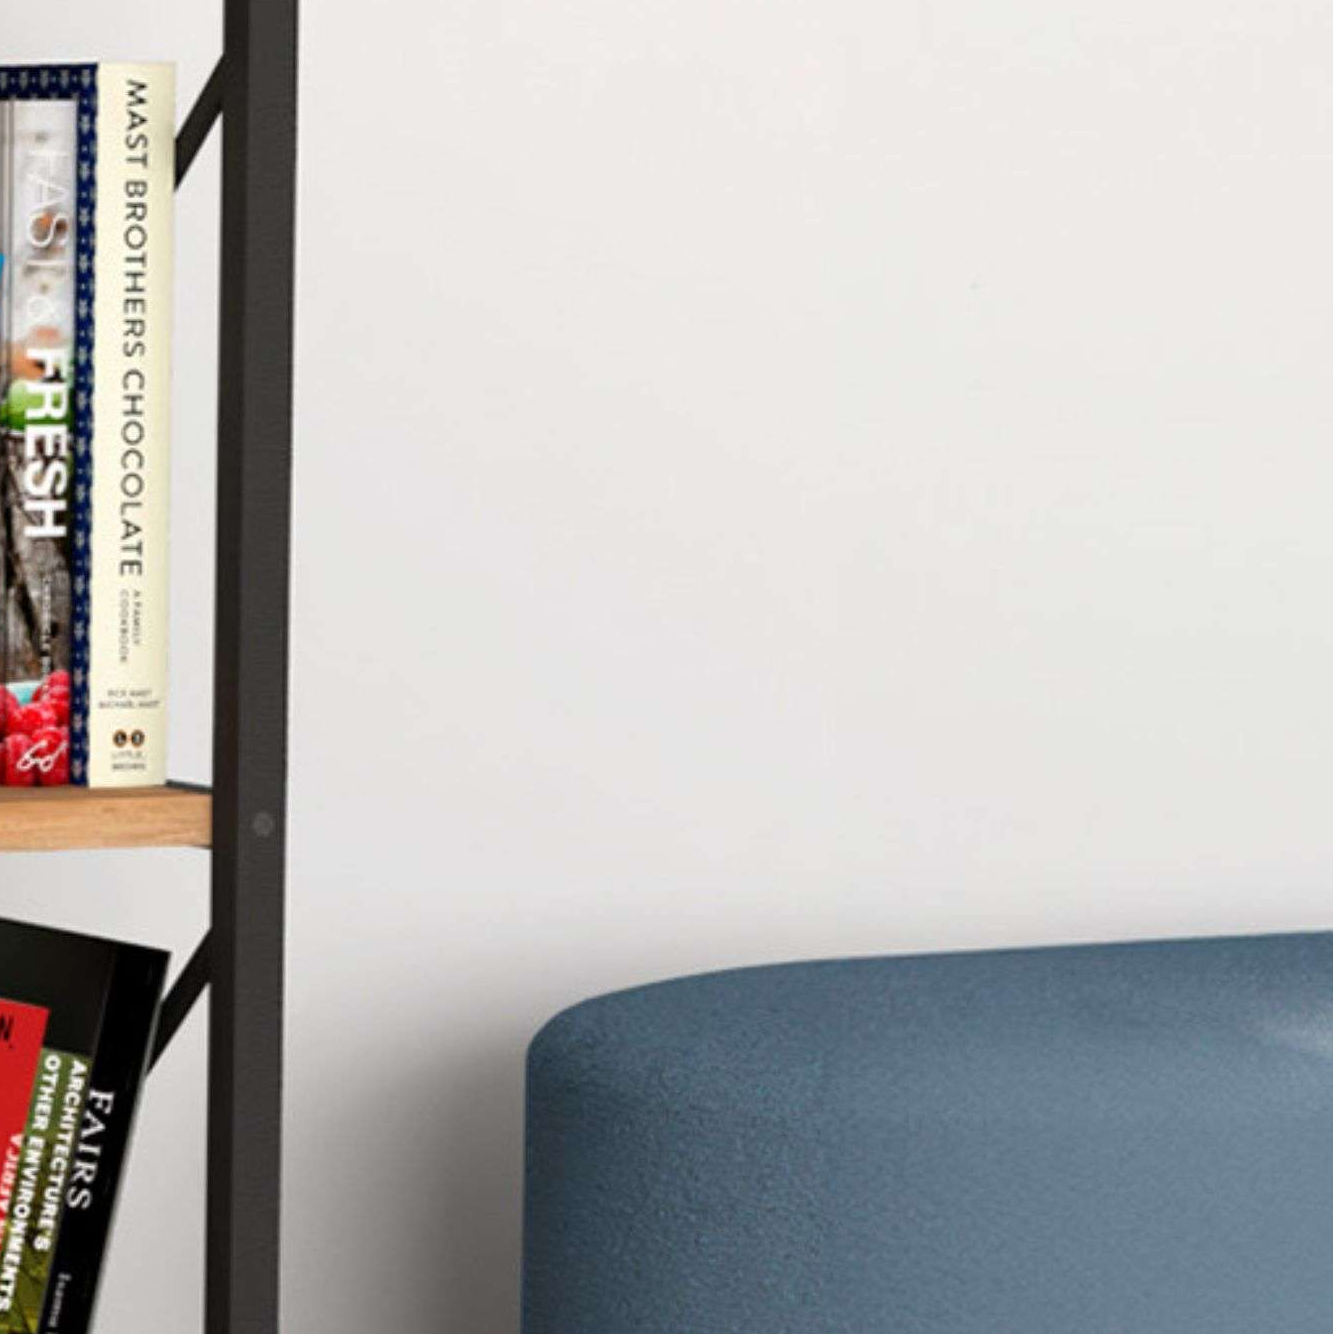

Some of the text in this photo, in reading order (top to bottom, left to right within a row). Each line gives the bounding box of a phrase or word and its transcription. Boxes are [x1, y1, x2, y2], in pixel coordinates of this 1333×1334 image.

[119, 78, 150, 576] MAST BROTHERS CHOCOLATE
[23, 347, 70, 538] FRESH
[34, 1053, 62, 1131] OTHER
[34, 1059, 88, 1252] ARCHITECTURE'S
[65, 1088, 115, 1210] FAIRS
